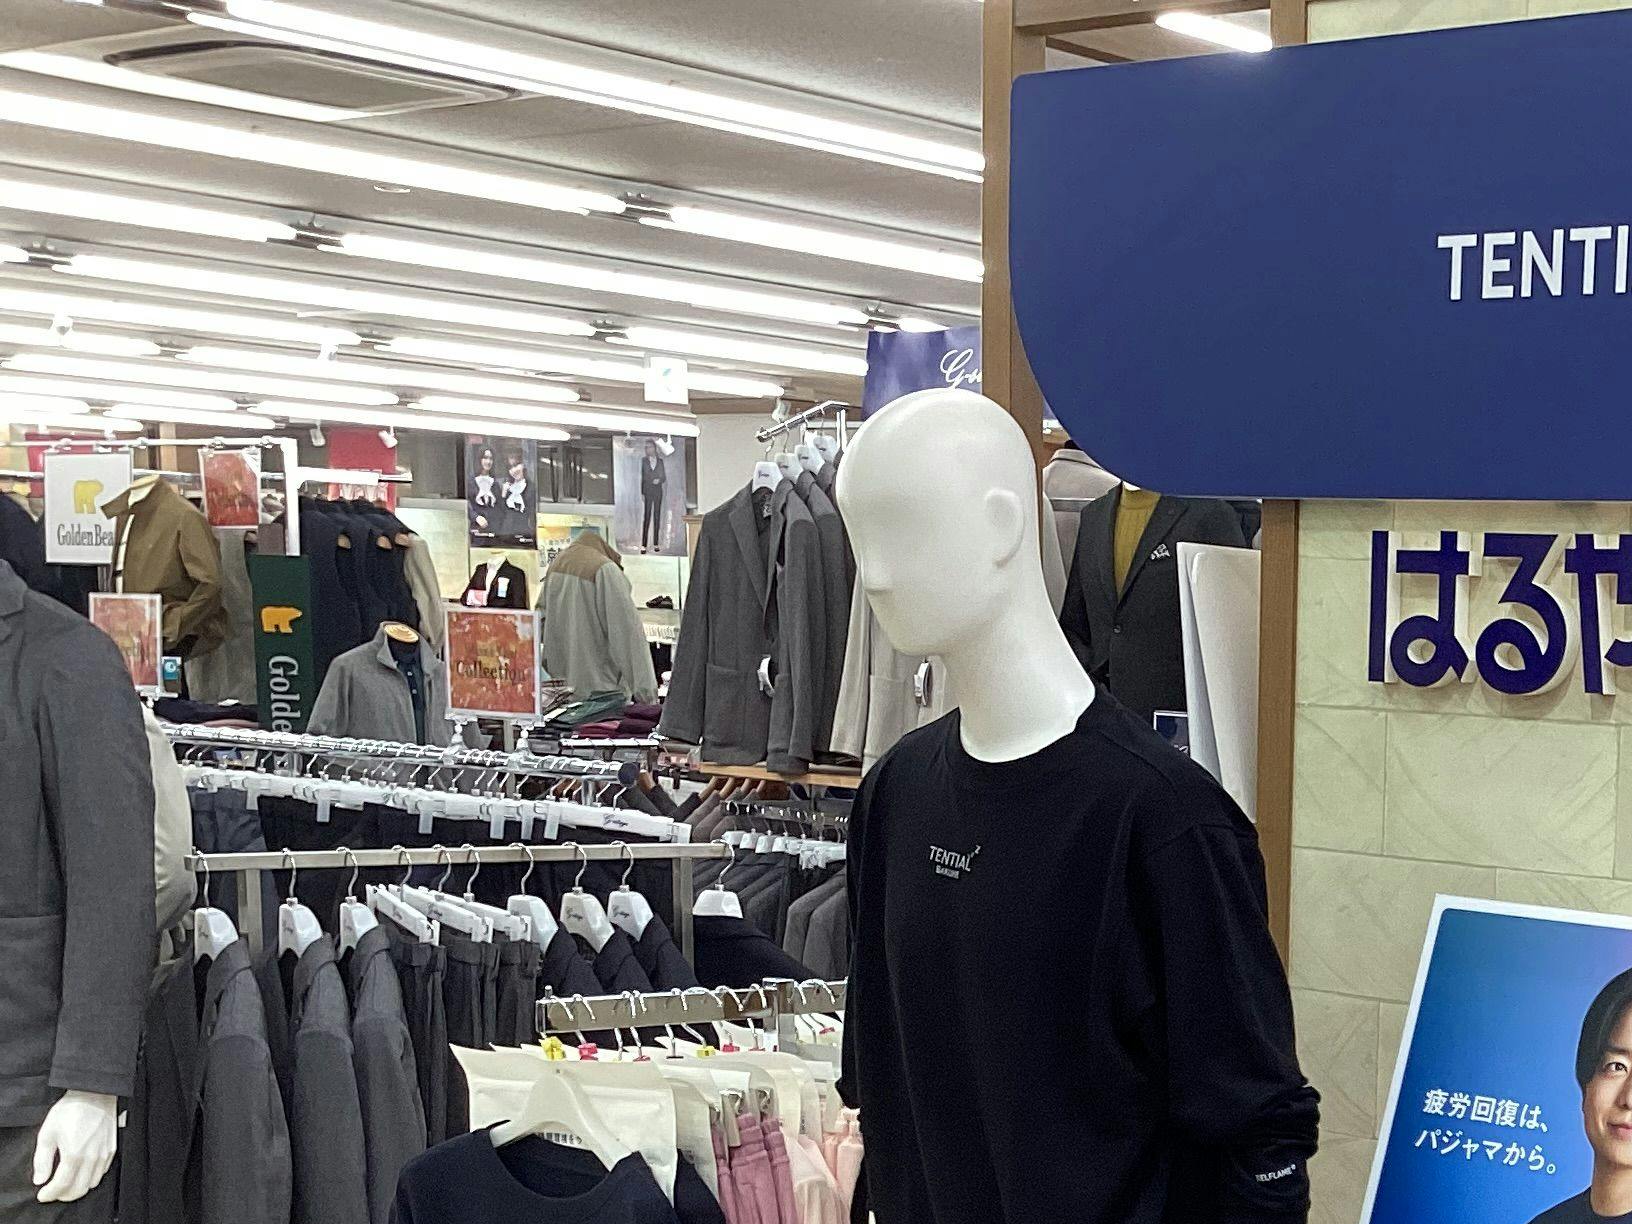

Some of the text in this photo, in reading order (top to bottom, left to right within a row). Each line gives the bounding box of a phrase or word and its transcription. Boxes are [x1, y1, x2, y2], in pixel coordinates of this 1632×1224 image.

[267, 655, 301, 733] Golde
[1422, 1088, 1549, 1133] 疲労回復は、
[1414, 1128, 1557, 1175] パジャマから。
